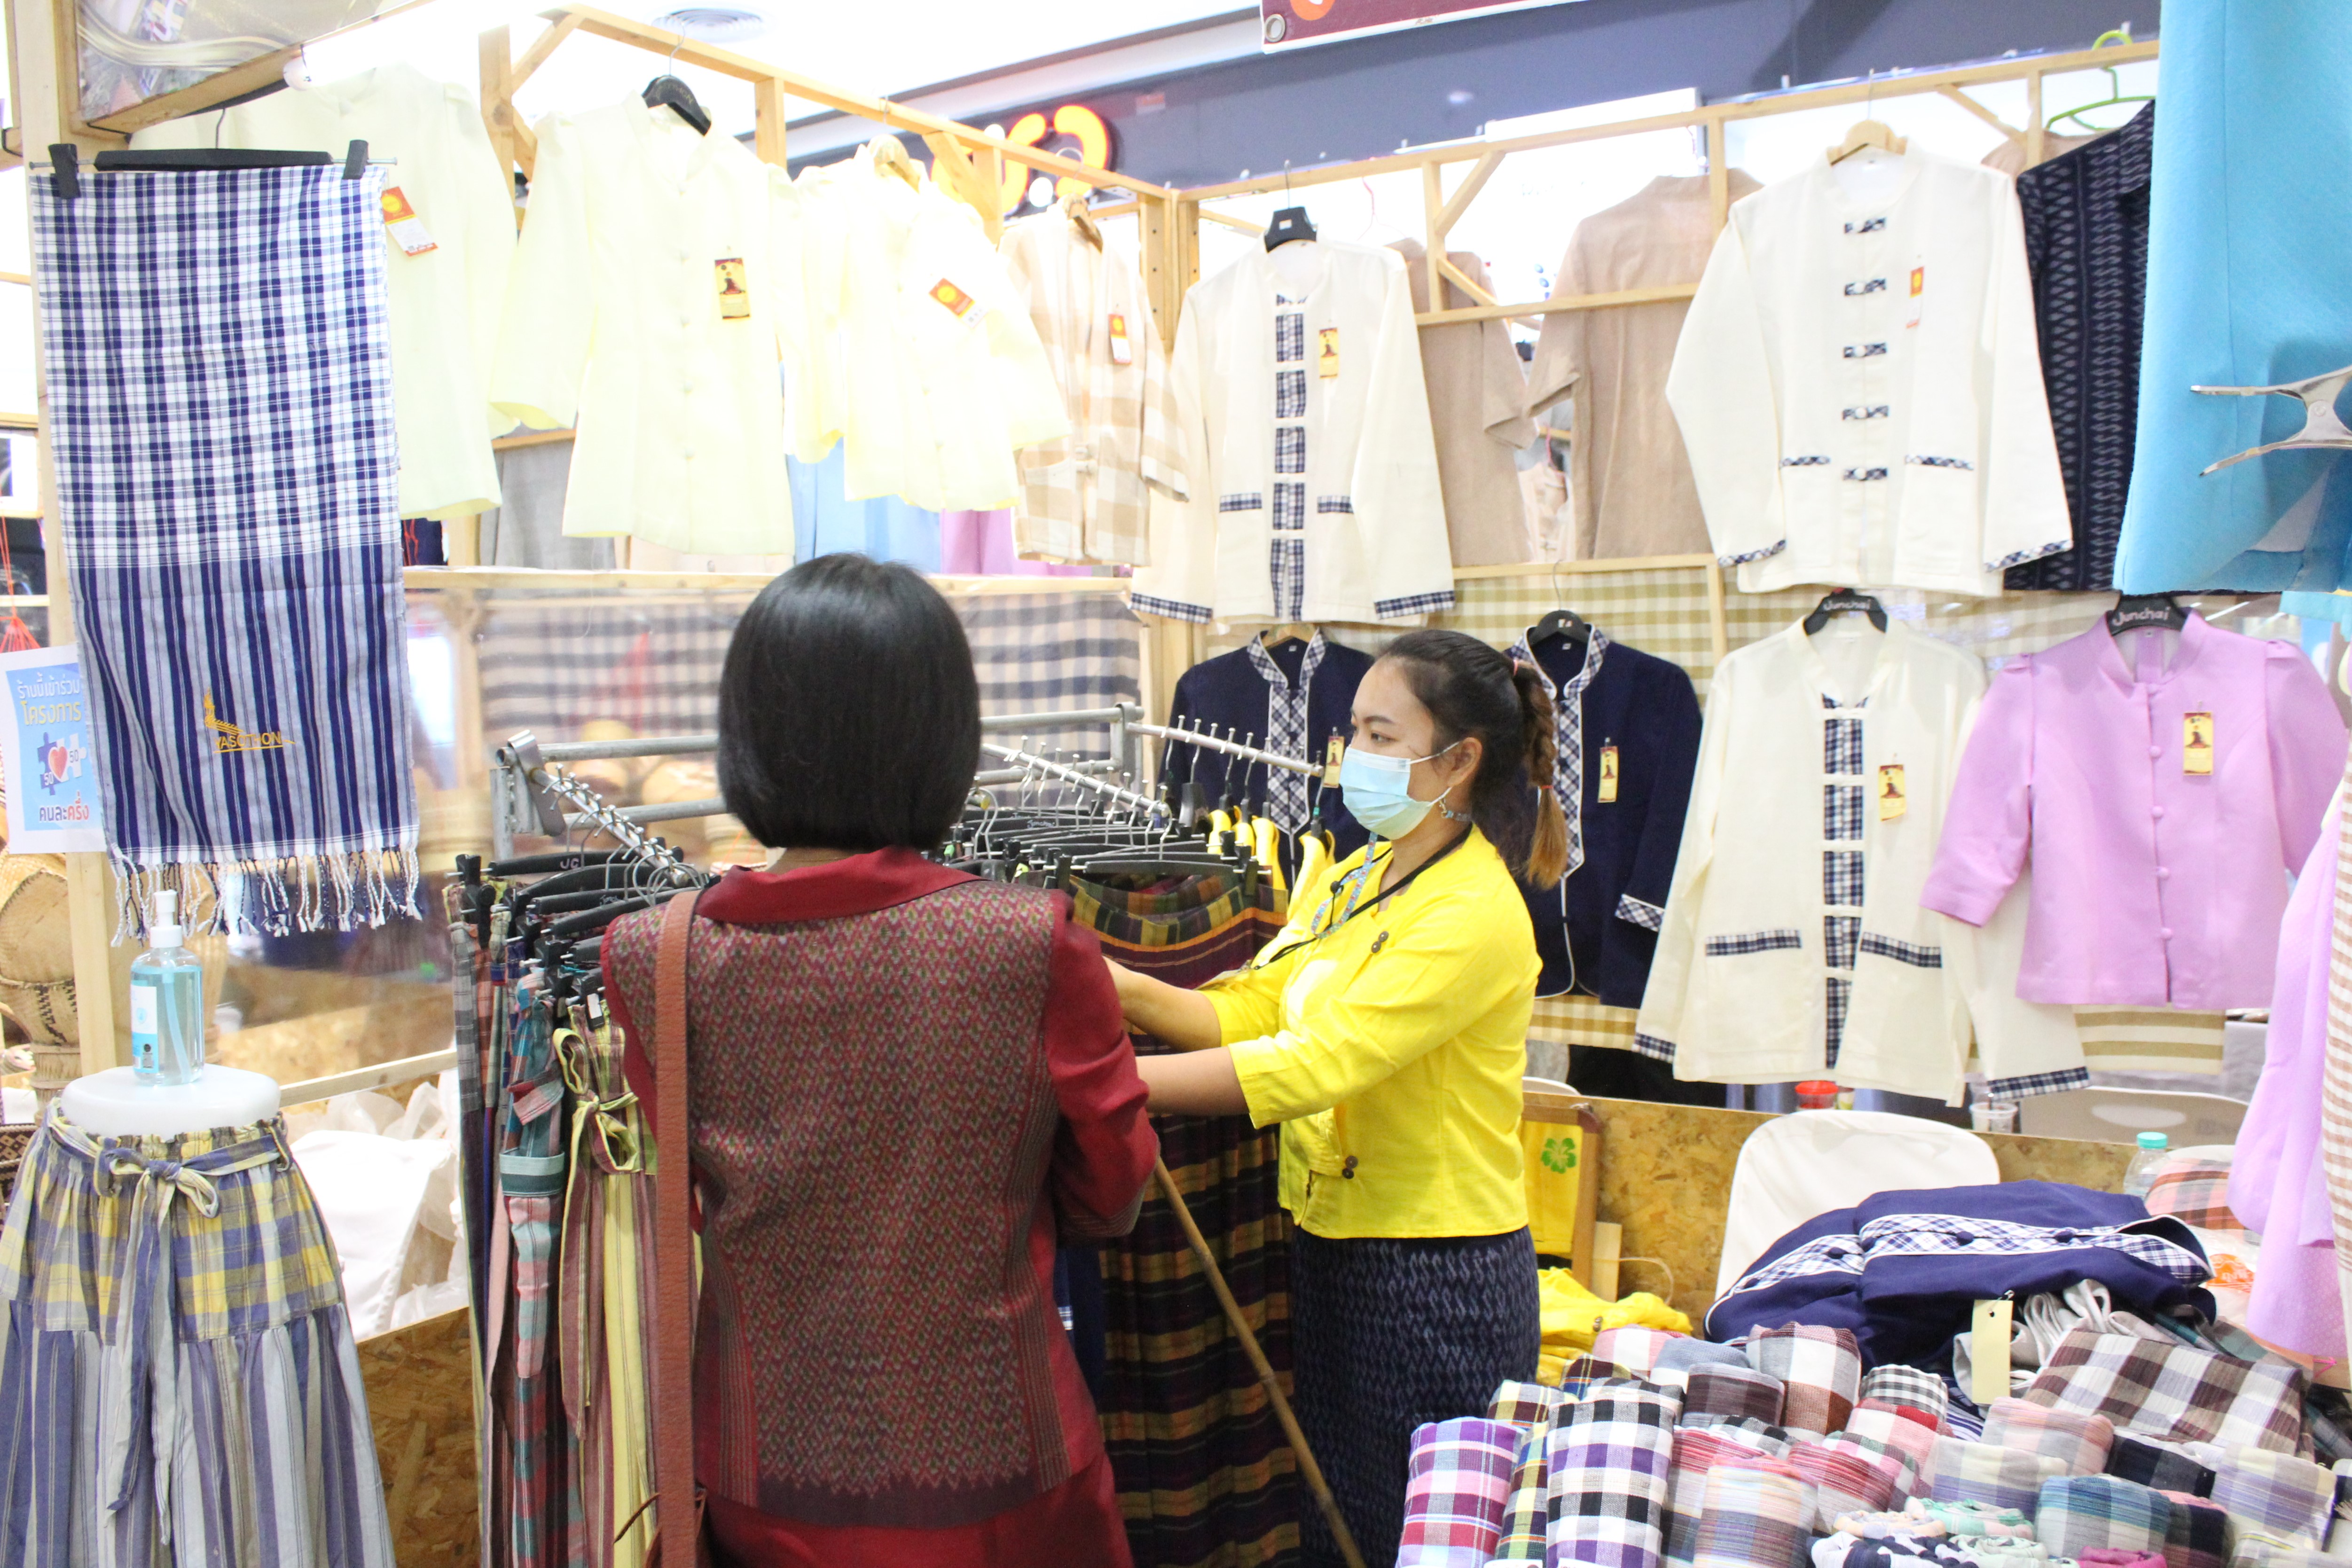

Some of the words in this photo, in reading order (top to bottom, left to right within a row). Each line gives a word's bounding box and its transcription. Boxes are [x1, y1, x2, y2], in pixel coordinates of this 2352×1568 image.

[2113, 607, 2171, 626] Junchai
[17, 672, 81, 699] ร้านนี้เข้าร่วม
[20, 701, 81, 725] โครงการ
[215, 731, 282, 749] YASOTHON
[69, 750, 79, 763] 50
[44, 772, 54, 785] 50
[39, 791, 89, 821] คนละครึ่ง
